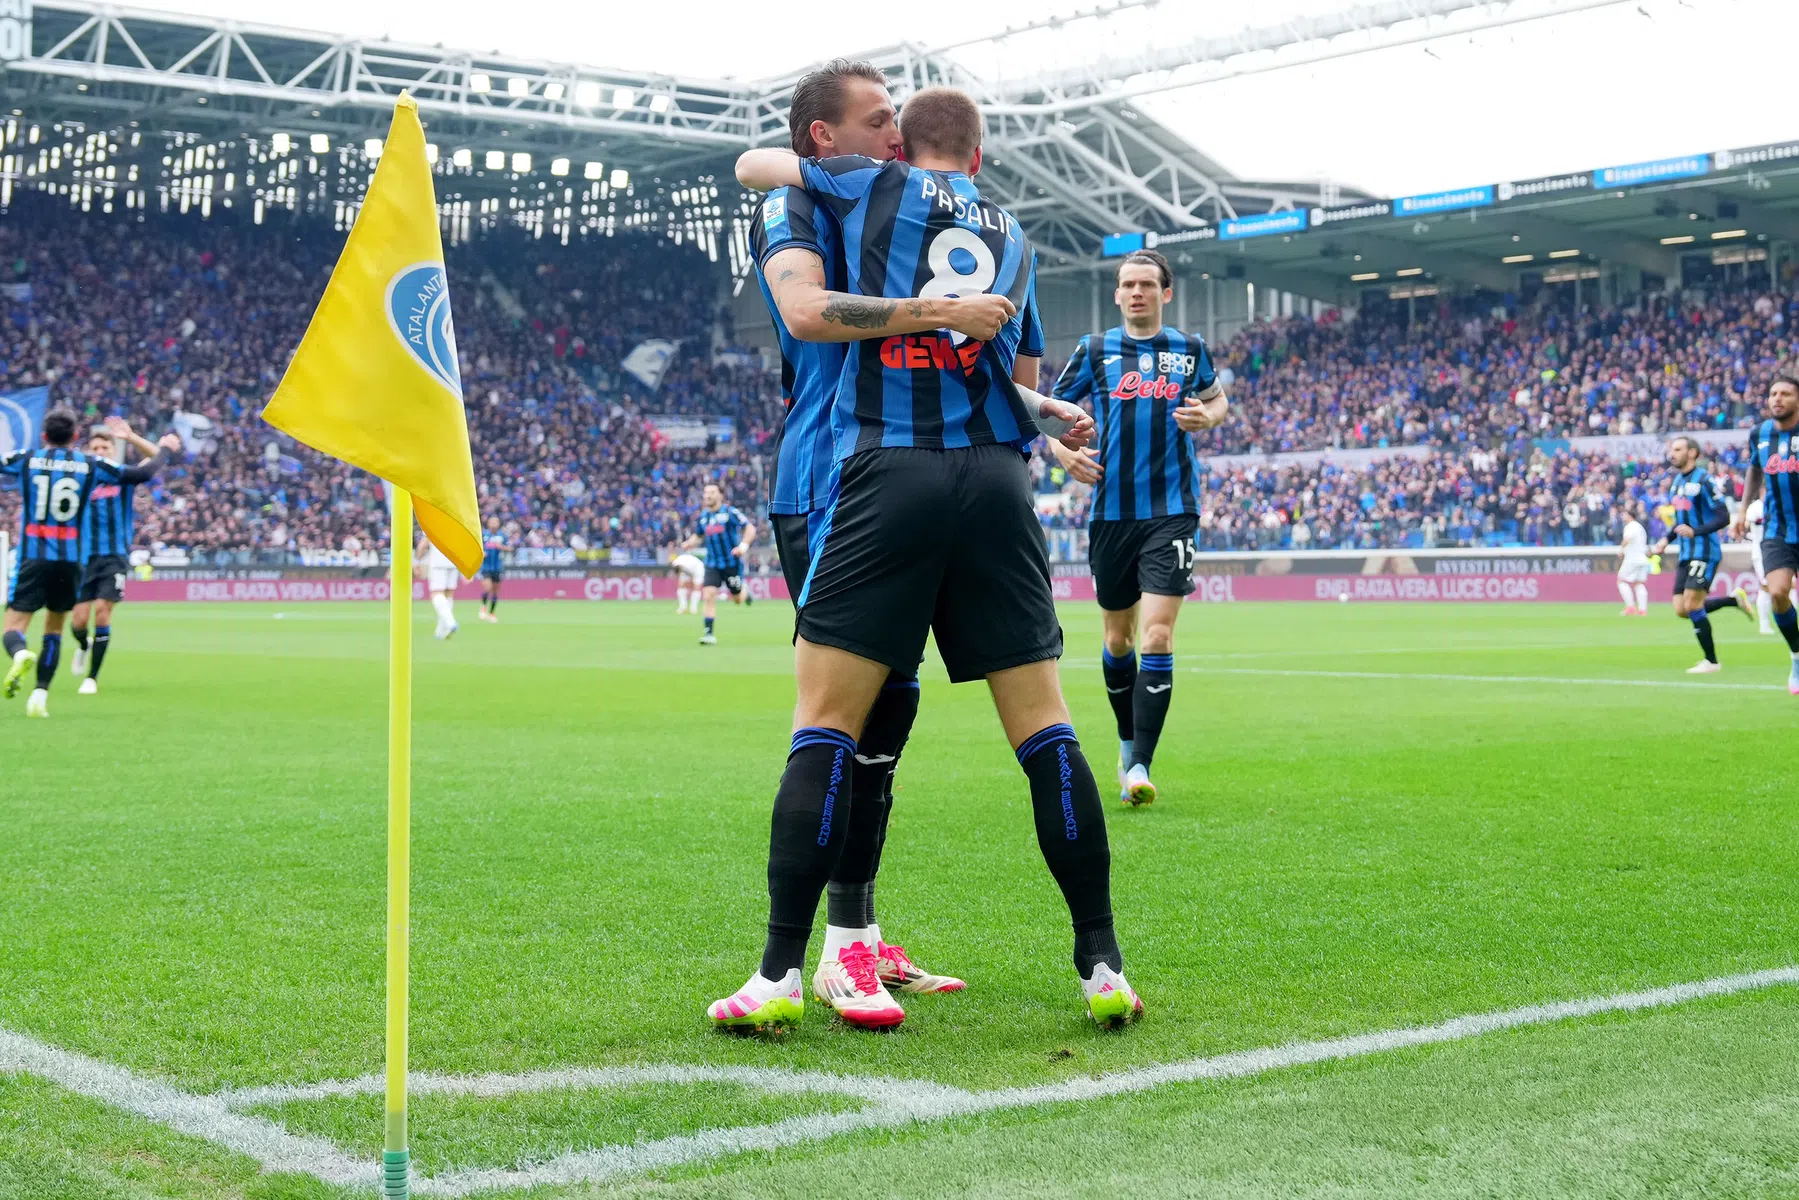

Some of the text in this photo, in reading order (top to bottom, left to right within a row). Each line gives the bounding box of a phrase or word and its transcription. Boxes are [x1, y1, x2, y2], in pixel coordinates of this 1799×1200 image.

[921, 177, 1017, 244] PAŠALIĆ
[919, 227, 996, 346] 8
[1158, 351, 1196, 367] RADICI
[1158, 362, 1195, 377] GROUP
[1109, 371, 1181, 400] Lete
[32, 474, 81, 522] 16
[1172, 539, 1196, 570] 15
[1531, 560, 1541, 574] A
[1689, 560, 1707, 577] 77
[187, 582, 233, 601] ENEL
[233, 582, 279, 601] RATA
[281, 582, 326, 601] VERA
[329, 582, 372, 600] LUCE
[374, 582, 390, 600] O
[584, 577, 654, 600] enel
[1315, 578, 1539, 599] ENEL RATA VERA LUCE O GAS
